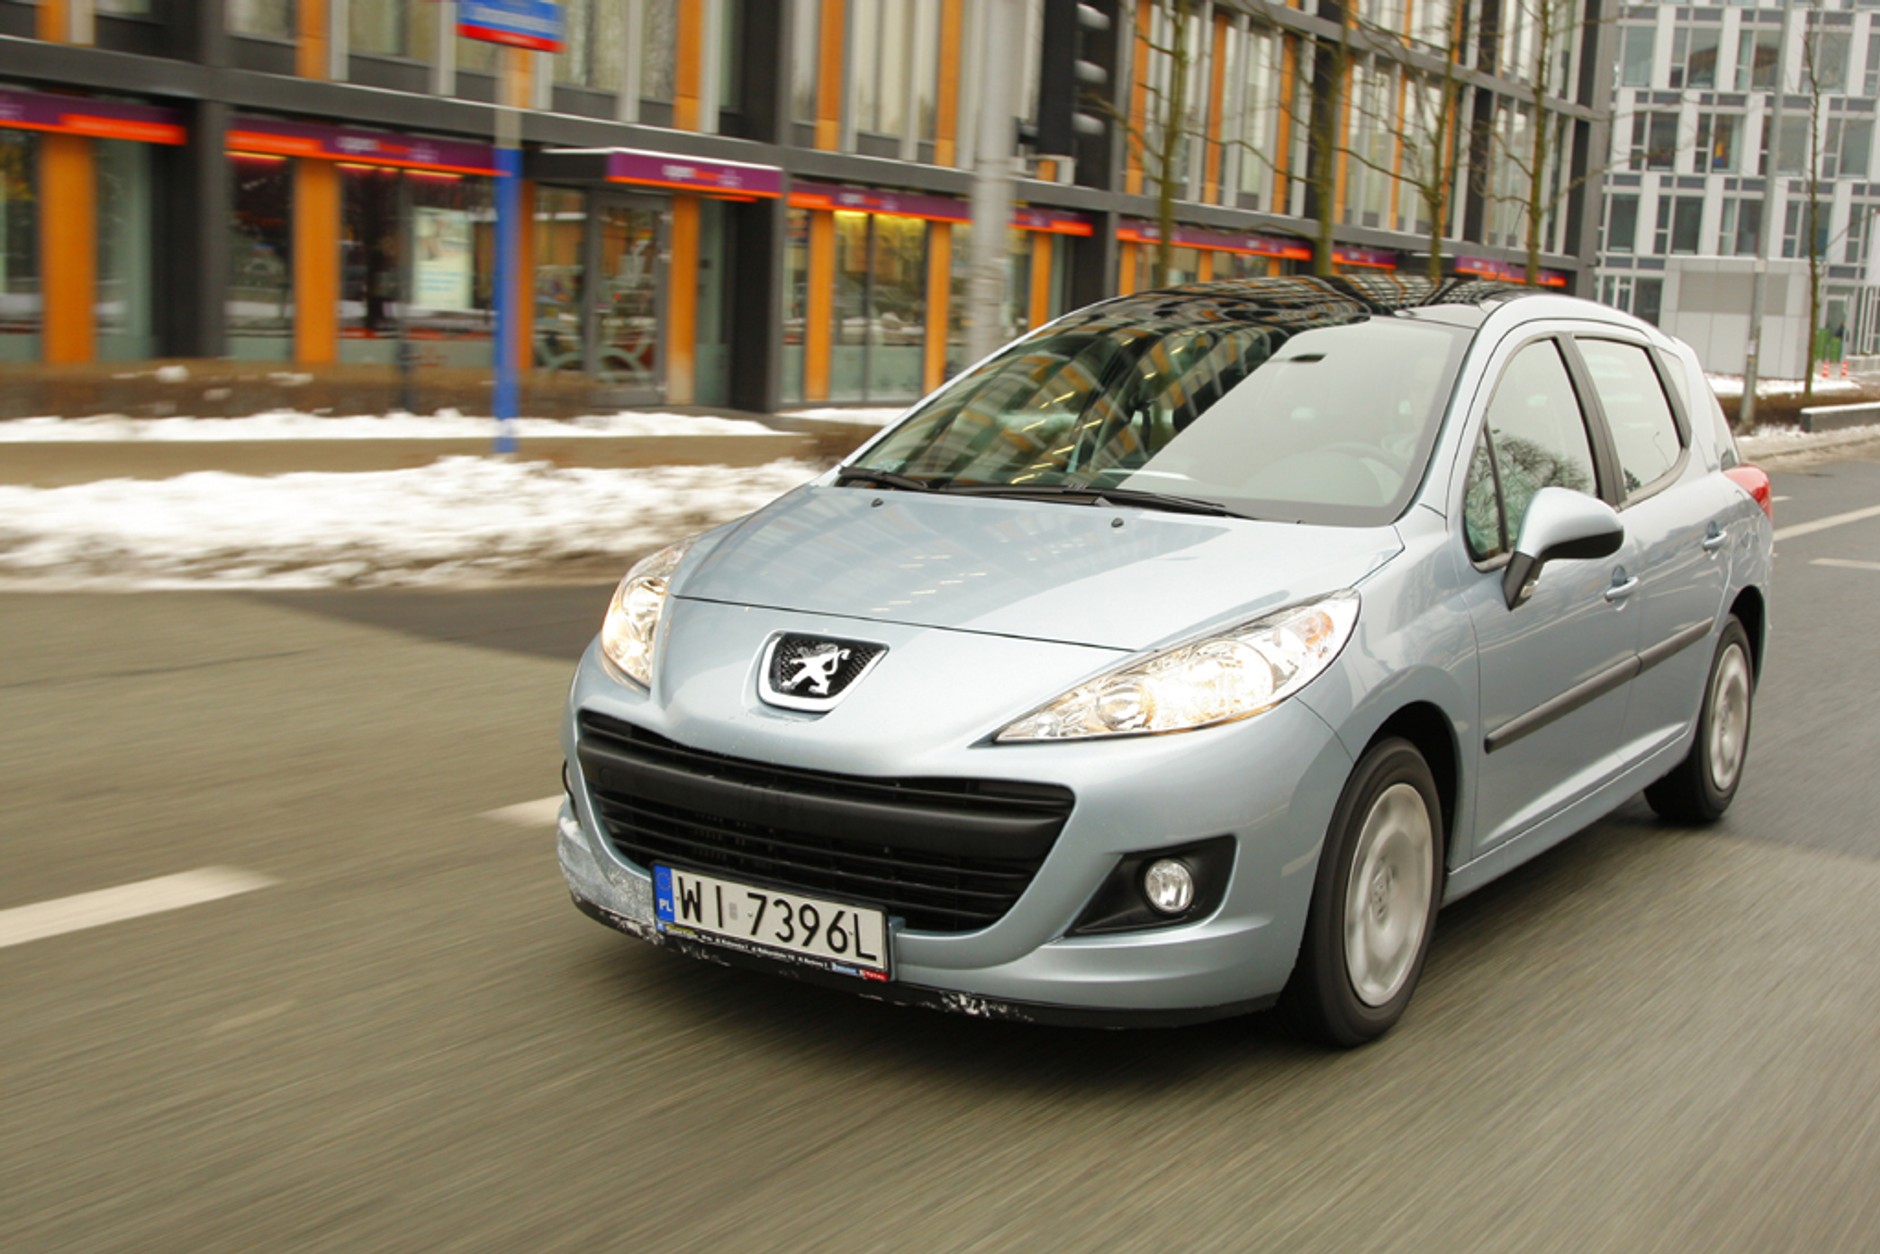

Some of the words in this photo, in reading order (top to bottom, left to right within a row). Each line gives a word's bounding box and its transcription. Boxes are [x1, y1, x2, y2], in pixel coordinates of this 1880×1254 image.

[659, 898, 673, 912] PL
[678, 876, 724, 928] WI
[746, 892, 877, 961] 7396L
